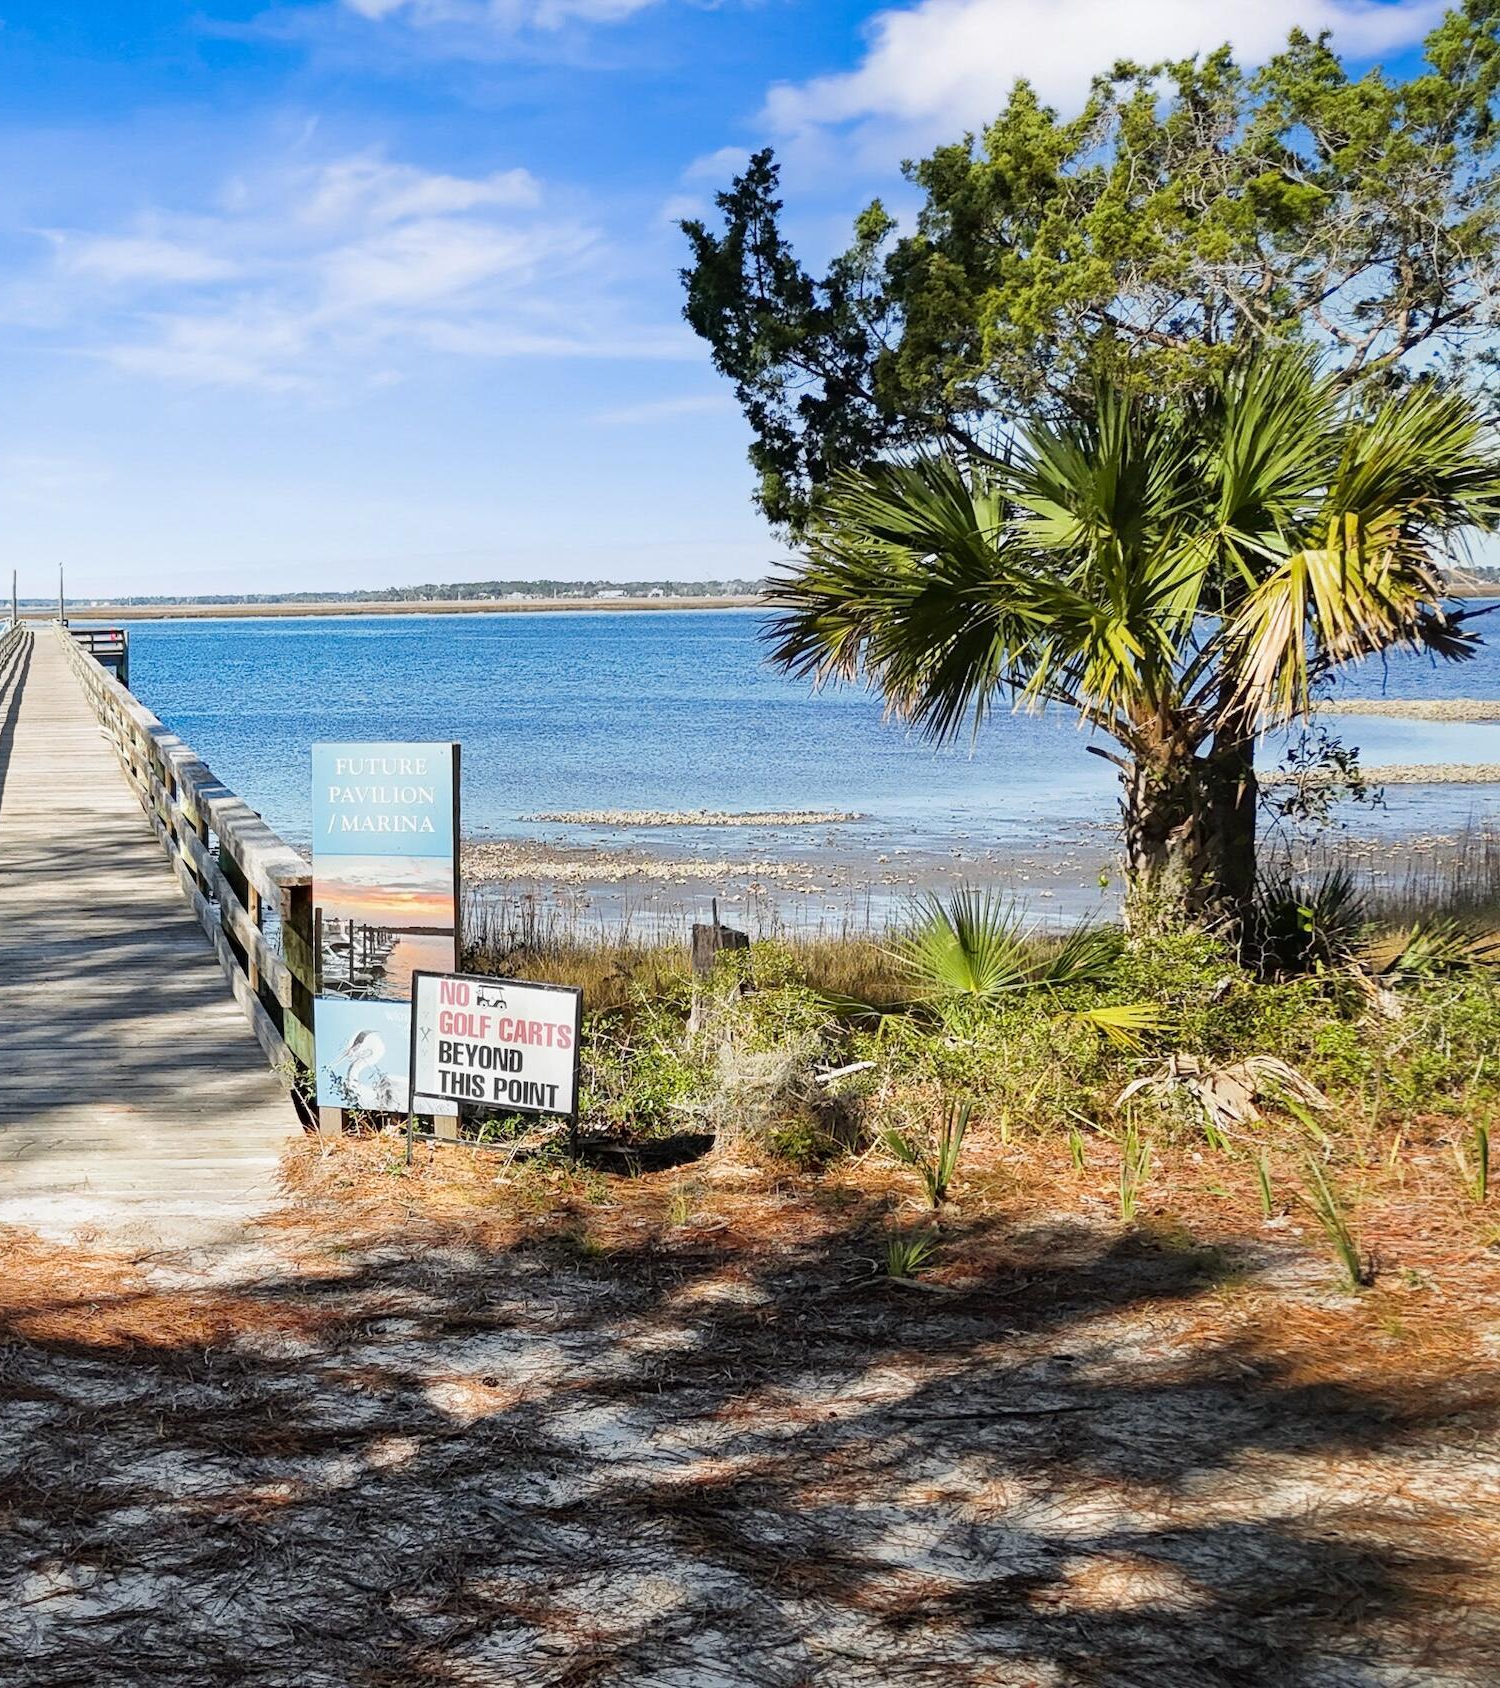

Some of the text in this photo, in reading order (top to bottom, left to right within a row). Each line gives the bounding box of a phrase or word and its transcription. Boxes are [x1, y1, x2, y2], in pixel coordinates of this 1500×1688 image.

[336, 758, 427, 776] FUTURE
[328, 786, 435, 804] PAVILION
[440, 981, 470, 1007] NO
[439, 1011, 491, 1039] GOLF
[499, 1018, 572, 1050] CARTS
[438, 1040, 523, 1073] BEYOND
[438, 1070, 559, 1108] THIS POINT
